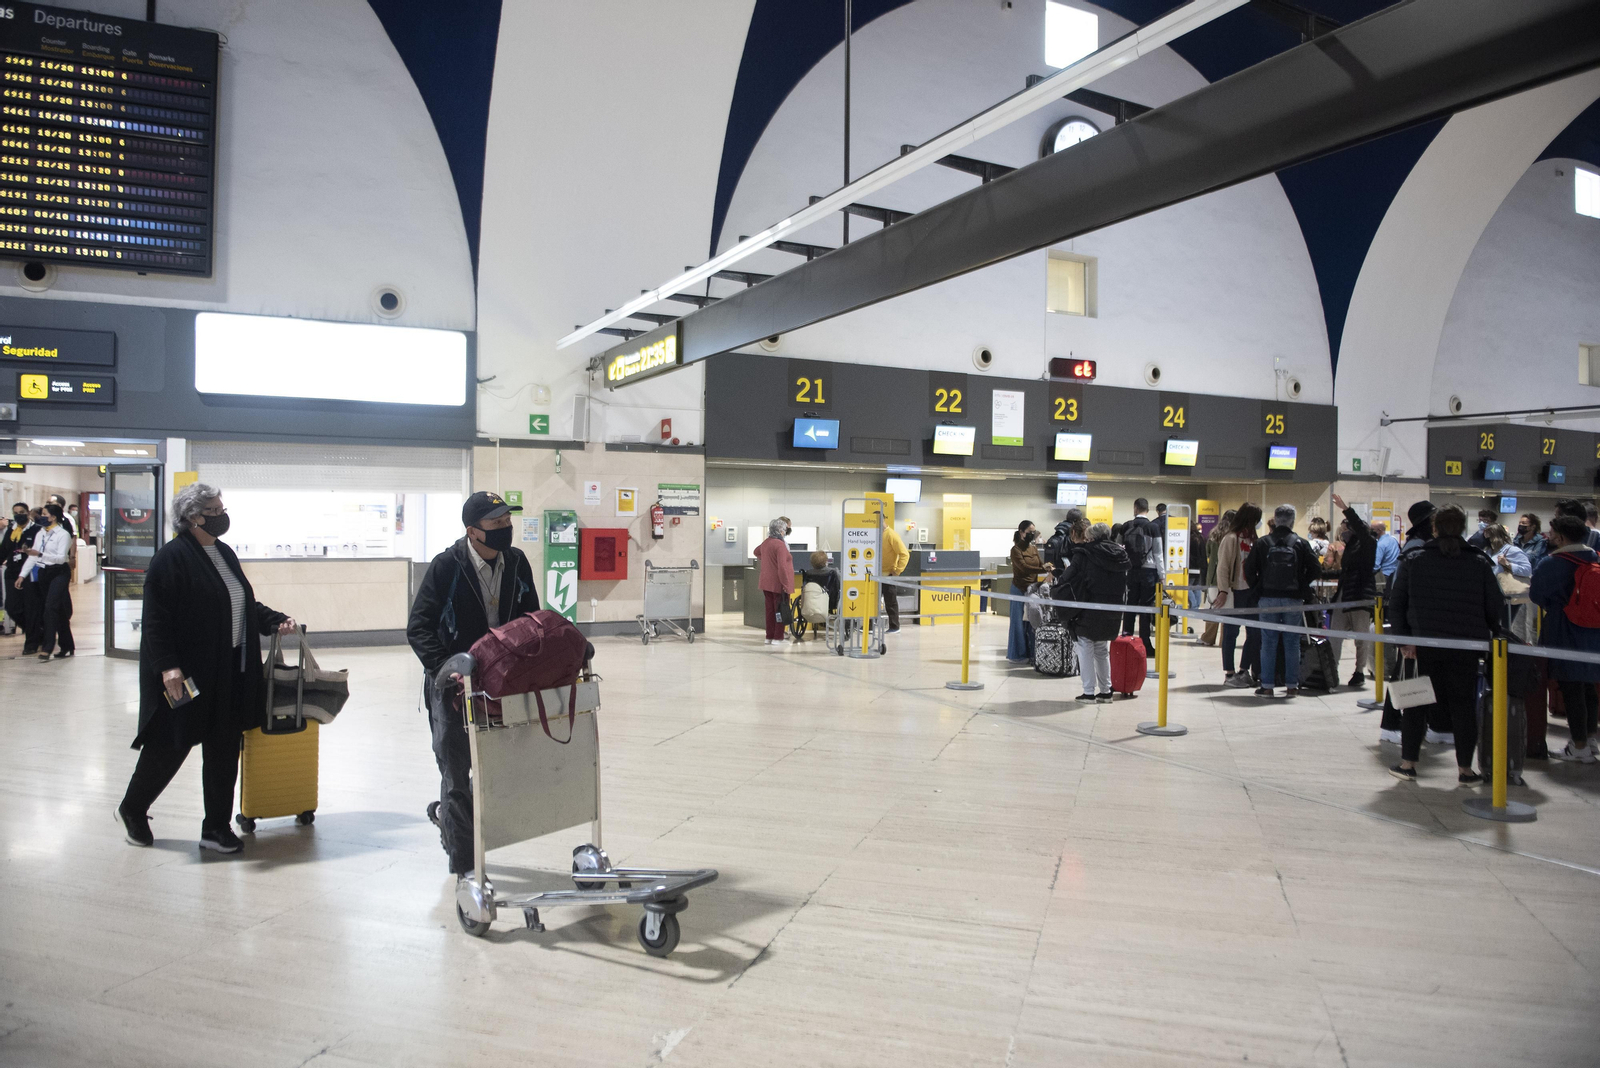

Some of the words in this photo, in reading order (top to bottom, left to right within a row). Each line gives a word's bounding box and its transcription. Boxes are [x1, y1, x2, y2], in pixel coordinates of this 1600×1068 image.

[34, 10, 122, 36] Departures
[41, 36, 67, 46] Counter
[82, 43, 110, 54] Boarding
[149, 52, 176, 63] Remarks
[41, 44, 74, 55] Mostrador
[82, 50, 116, 61] Embarque
[149, 60, 193, 73] Observaciones
[5, 56, 33, 66] 3949
[3, 89, 32, 100] 6912
[1, 155, 29, 166] 2213
[116, 234, 129, 243] 11
[3, 345, 58, 358] Seguridad
[796, 378, 825, 403] 21
[935, 389, 962, 413] 22
[1054, 398, 1078, 421] 23
[1163, 406, 1185, 428] 24
[1266, 414, 1284, 435] 25
[1480, 433, 1494, 450] 26
[1543, 438, 1556, 455] 27
